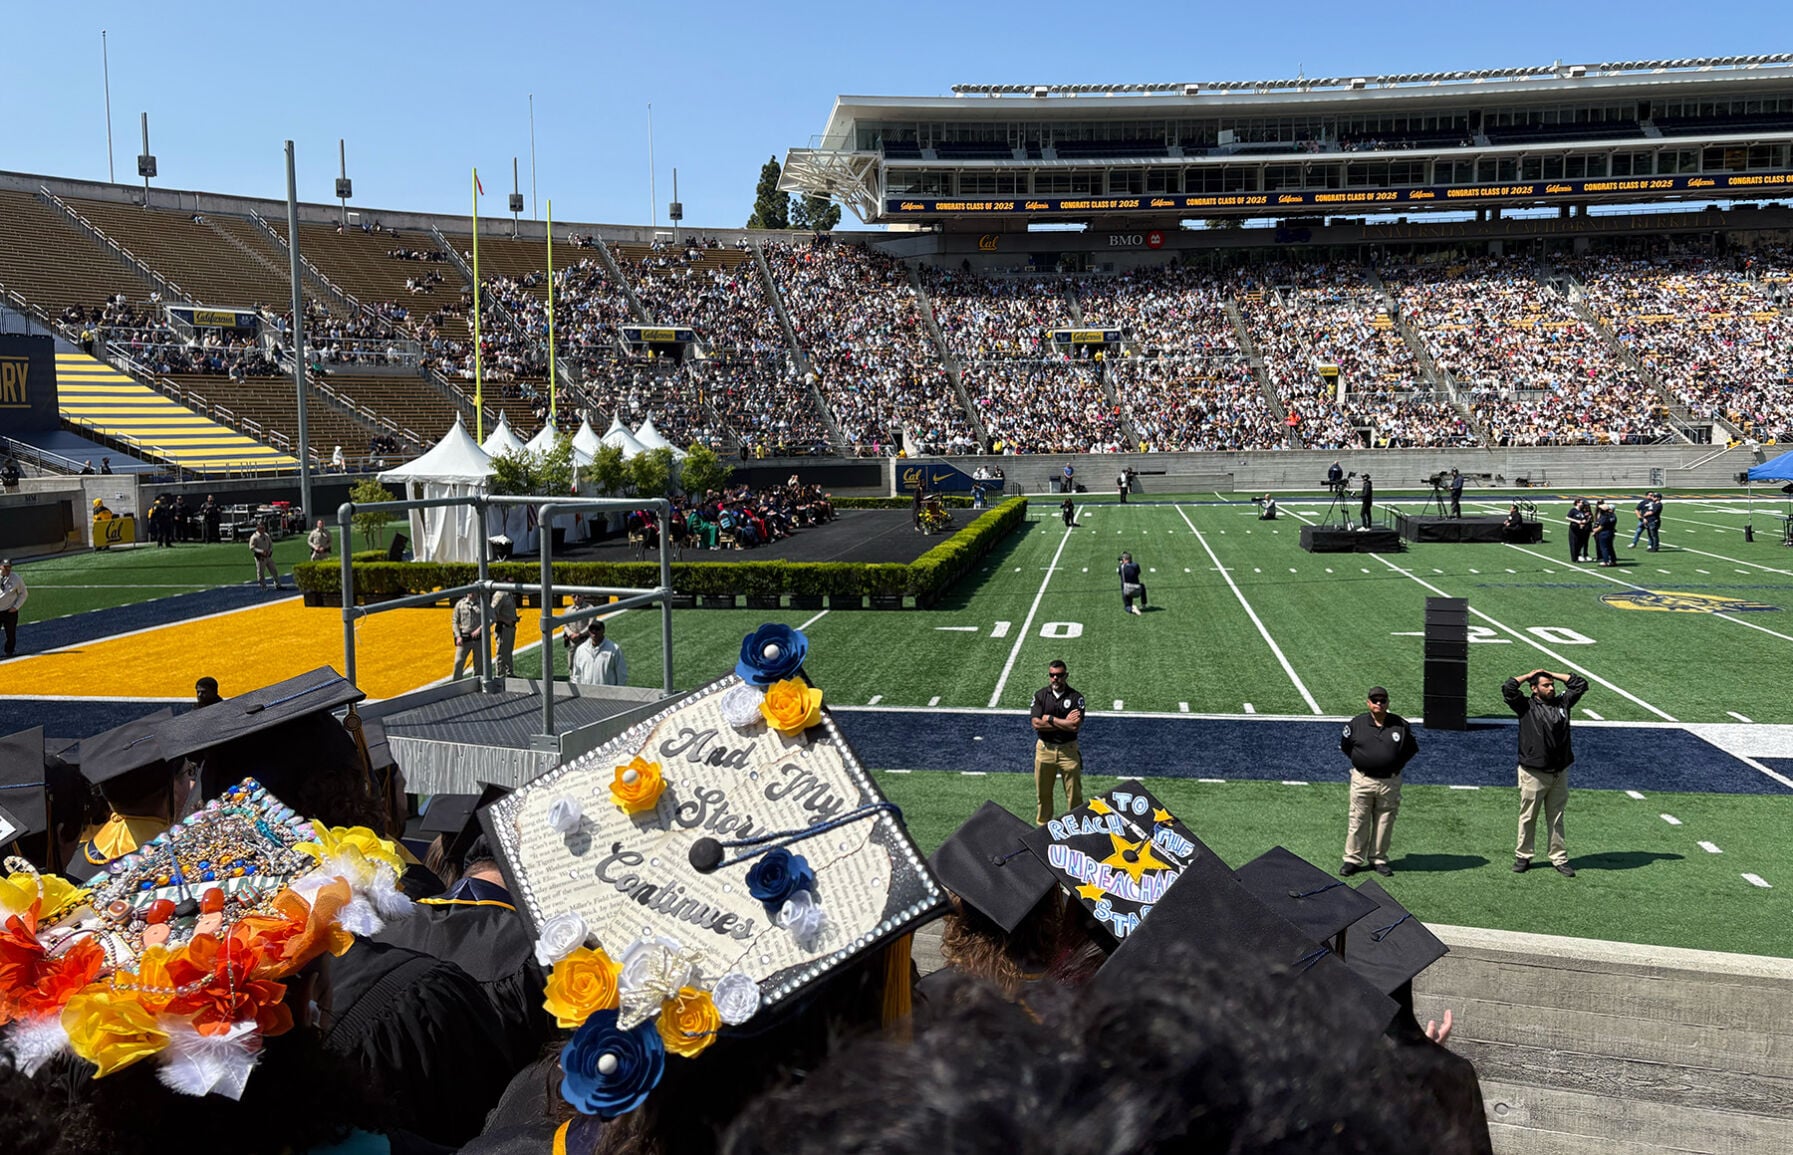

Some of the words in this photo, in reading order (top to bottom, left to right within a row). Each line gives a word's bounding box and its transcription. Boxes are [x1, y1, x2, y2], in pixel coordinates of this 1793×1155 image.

[1584, 182, 1617, 191] CONGRATS
[1619, 181, 1639, 190] CLASS
[1640, 181, 1648, 189] OF
[1649, 180, 1673, 189] 2025
[1688, 178, 1715, 187] California
[1728, 176, 1763, 185] CONGRATS
[1764, 175, 1785, 184] CLASS
[1410, 190, 1435, 198] California
[1447, 189, 1480, 197] CONGRATS
[1480, 188, 1500, 196] CLASS
[1501, 187, 1509, 195] OF
[1510, 186, 1533, 194] 2025
[1545, 185, 1572, 193] California
[1186, 198, 1216, 206] CONGRATS
[1218, 196, 1236, 205] CLASS
[1237, 196, 1244, 204] OF
[1245, 196, 1267, 204] 2025
[1279, 195, 1303, 203] California
[1315, 193, 1346, 202] CONGRATS
[1347, 192, 1366, 201] CLASS
[1367, 192, 1375, 200] OF
[1375, 192, 1398, 200] 2025
[900, 201, 924, 210] California
[935, 202, 965, 210] CONGRATS
[966, 202, 984, 210] CLASS
[985, 202, 993, 210] OF
[993, 202, 1014, 210] 2025
[1025, 201, 1049, 210] California
[1110, 200, 1117, 208] OF
[1118, 200, 1139, 208] 2025
[1151, 199, 1174, 207] California
[979, 234, 999, 250] Cal
[1109, 234, 1143, 246] BMO
[0, 362, 29, 403] RY
[903, 467, 922, 483] Cal
[105, 521, 124, 541] Cal
[659, 727, 756, 769] And
[764, 763, 844, 825] My
[1112, 791, 1148, 815] TO
[1048, 814, 1125, 841] REACH
[1153, 823, 1195, 858] THE
[595, 842, 754, 940] Continues
